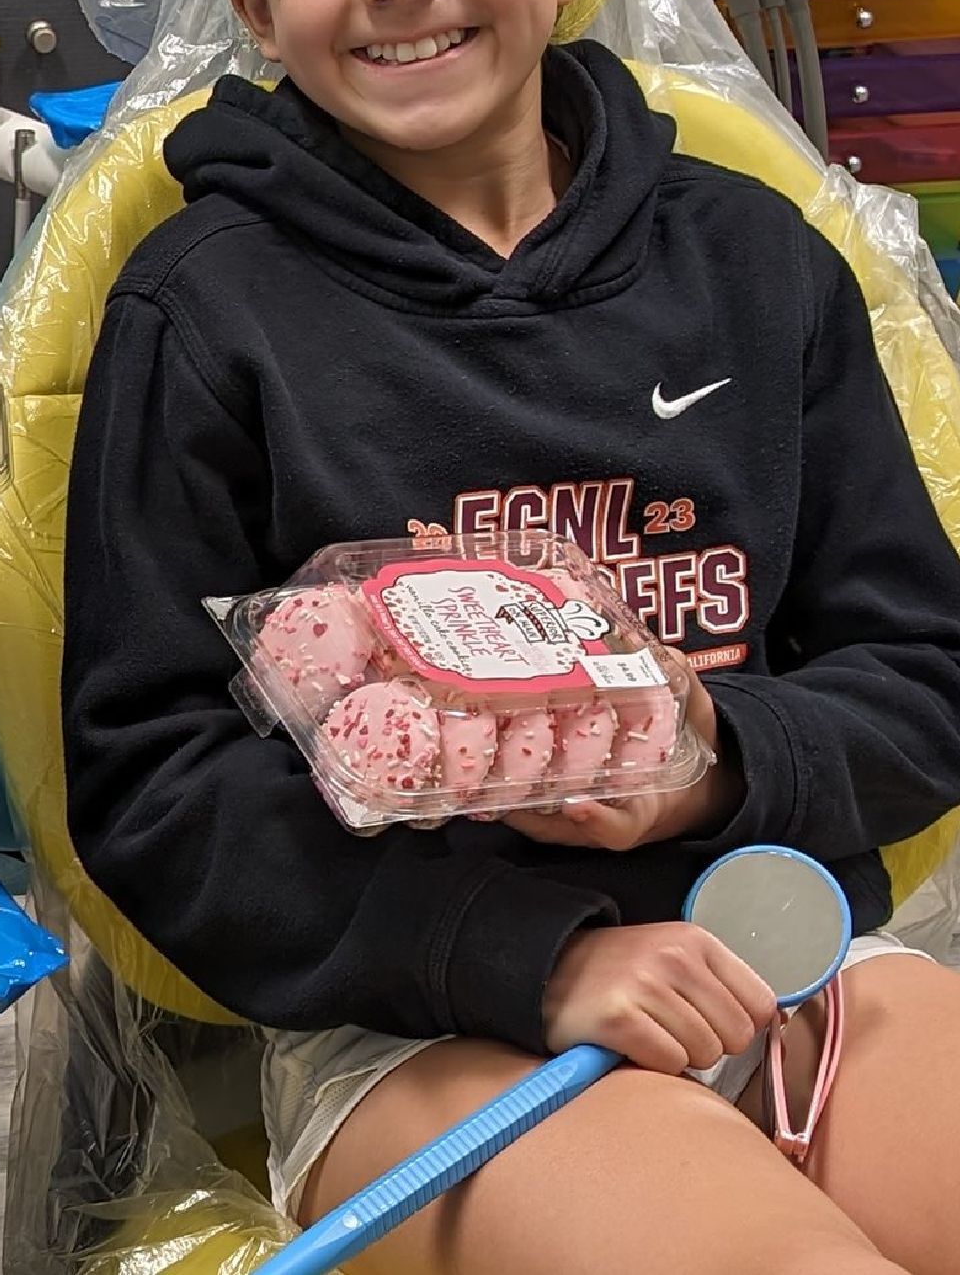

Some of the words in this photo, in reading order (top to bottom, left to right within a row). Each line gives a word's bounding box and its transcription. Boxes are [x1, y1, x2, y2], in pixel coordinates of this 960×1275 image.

[455, 478, 639, 569] ECNL
[643, 497, 696, 534] 23
[430, 597, 493, 657] SPRINKLE
[447, 585, 531, 666] SWEETHEART
[597, 544, 750, 643] FFS
